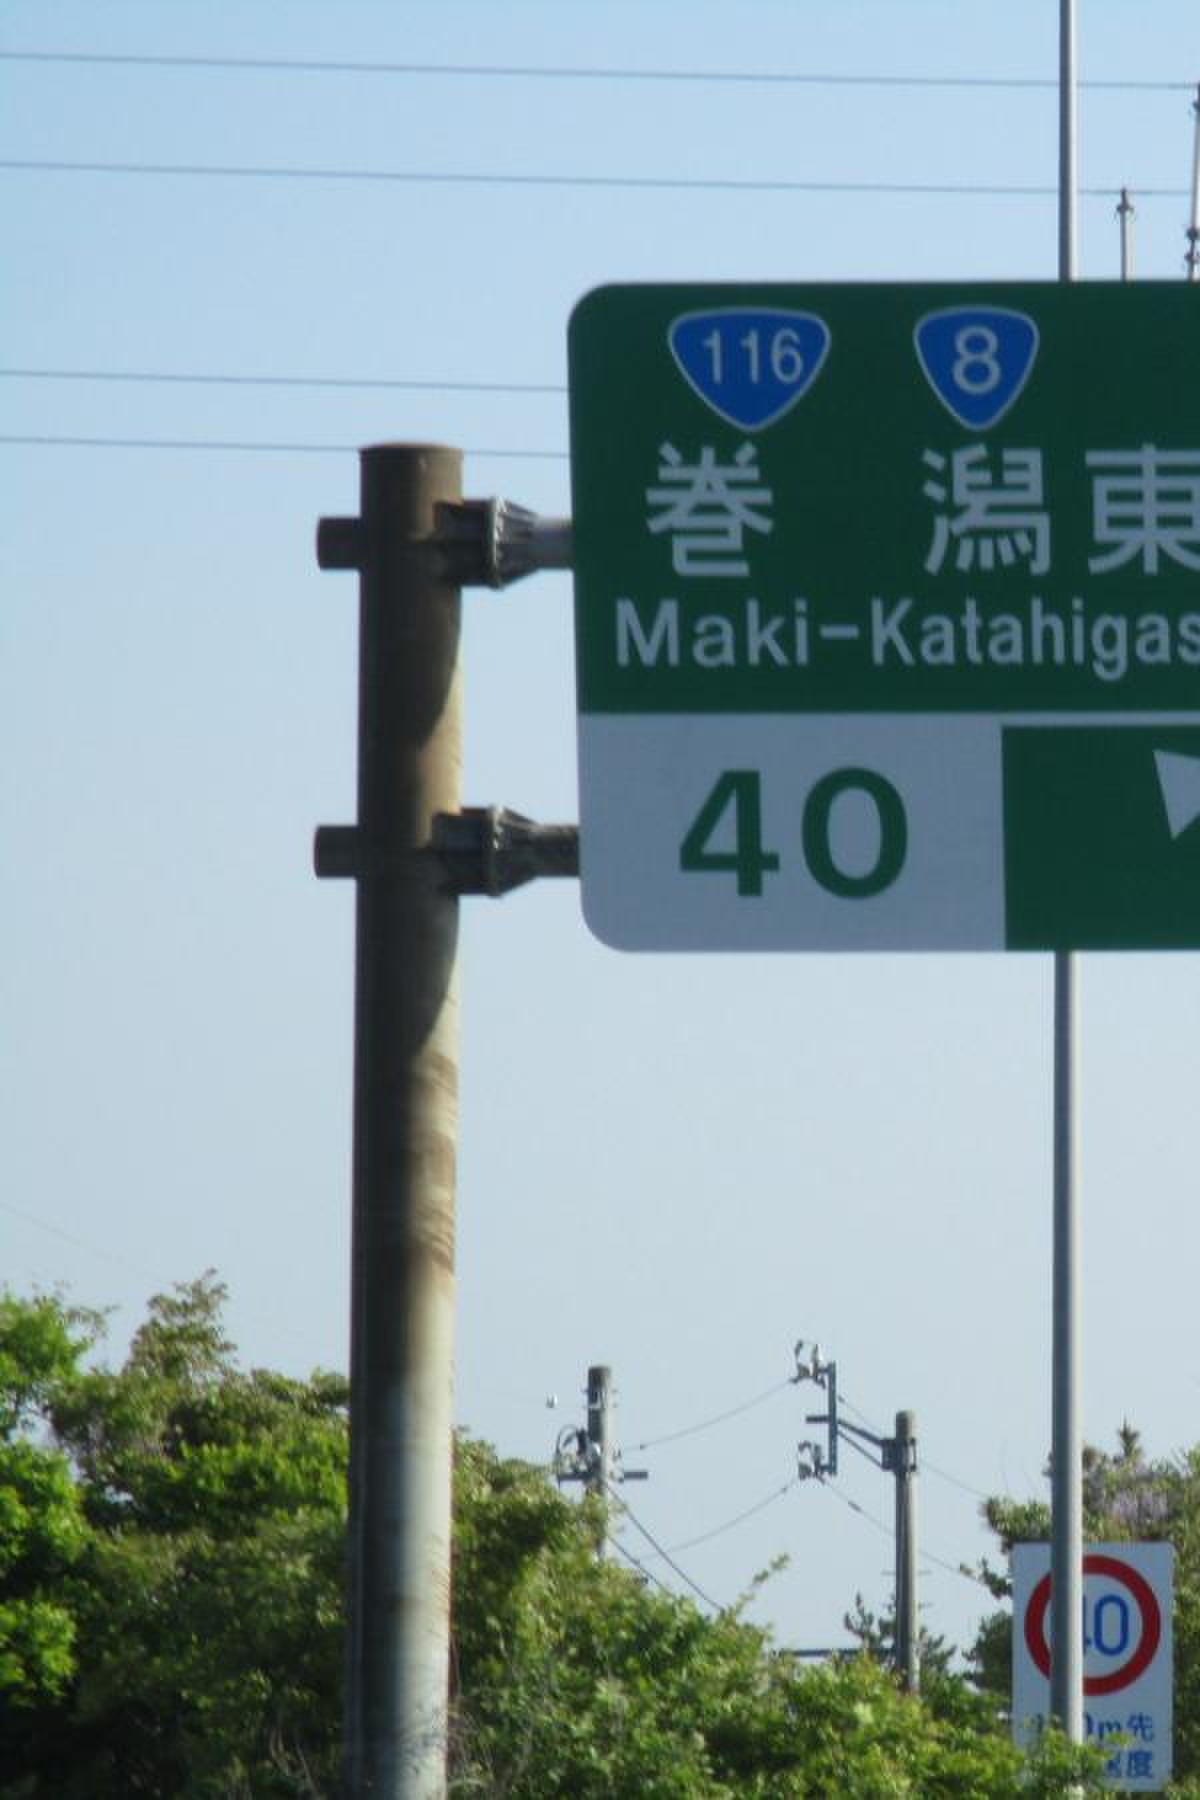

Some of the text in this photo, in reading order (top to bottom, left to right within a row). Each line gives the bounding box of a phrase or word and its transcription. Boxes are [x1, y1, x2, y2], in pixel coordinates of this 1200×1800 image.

[703, 329, 803, 385] 116
[952, 326, 1001, 394] 8
[645, 442, 773, 577] 巻
[679, 766, 908, 900] 40
